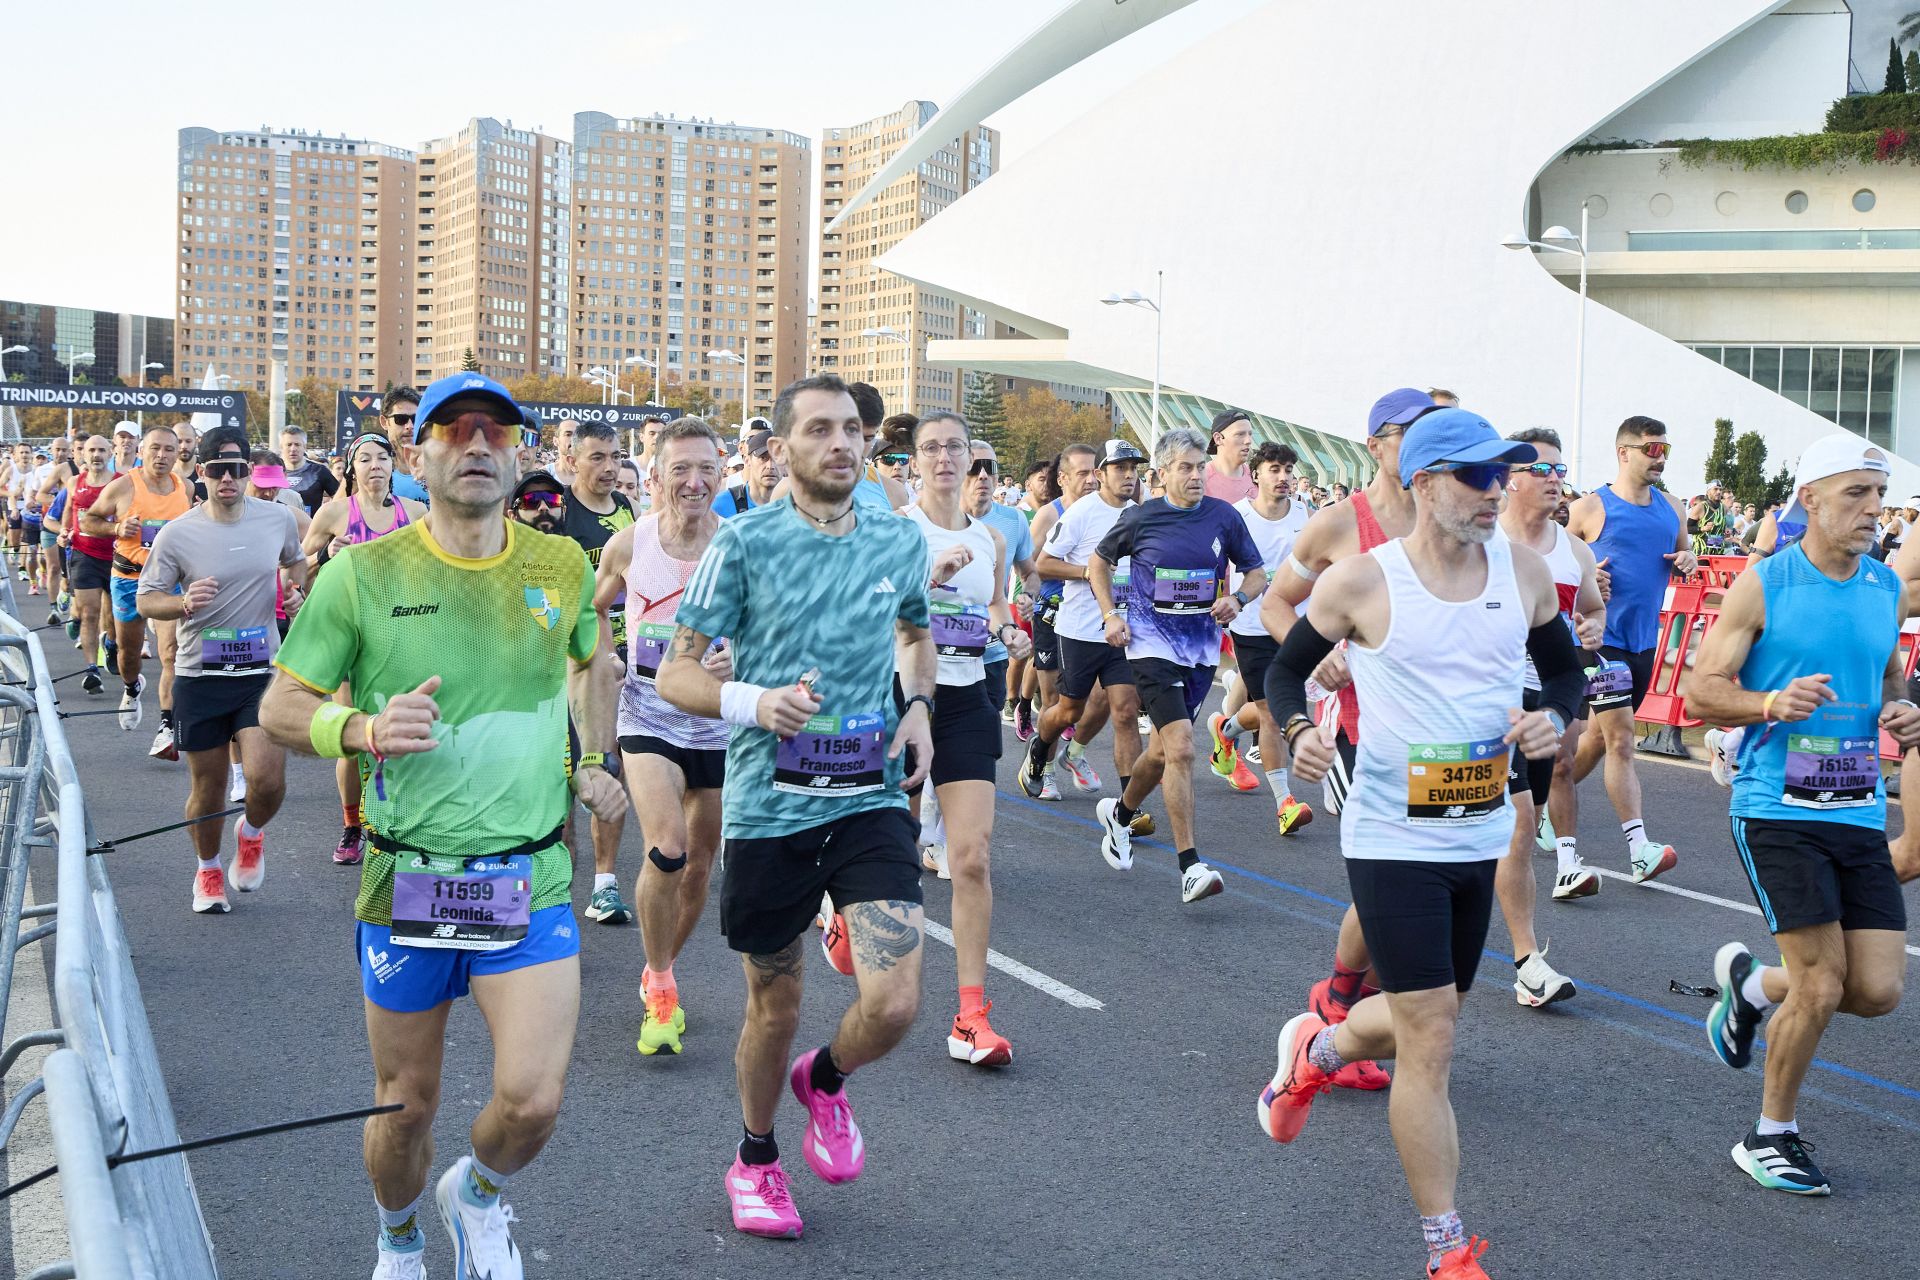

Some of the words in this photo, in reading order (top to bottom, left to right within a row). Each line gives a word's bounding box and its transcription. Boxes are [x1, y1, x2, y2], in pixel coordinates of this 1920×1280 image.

[1, 388, 80, 403] TRINIDAD
[80, 391, 159, 406] ALFONSO
[180, 396, 218, 406] ZURICH
[1172, 581, 1200, 591] 13996
[391, 602, 440, 617] Santini
[220, 642, 252, 652] 11621
[220, 653, 253, 662] MATTEO
[812, 737, 861, 755] 11596
[799, 757, 866, 773] Francesco
[1817, 757, 1858, 772] 15152
[1442, 763, 1493, 784] 34785
[1802, 775, 1837, 787] ALMA
[1840, 774, 1866, 787] LUNA
[1428, 781, 1500, 802] EVANGELOS
[488, 862, 519, 870] ZURICH
[432, 880, 494, 901] 11599
[430, 903, 494, 922] Leonida
[468, 932, 491, 940] balance
